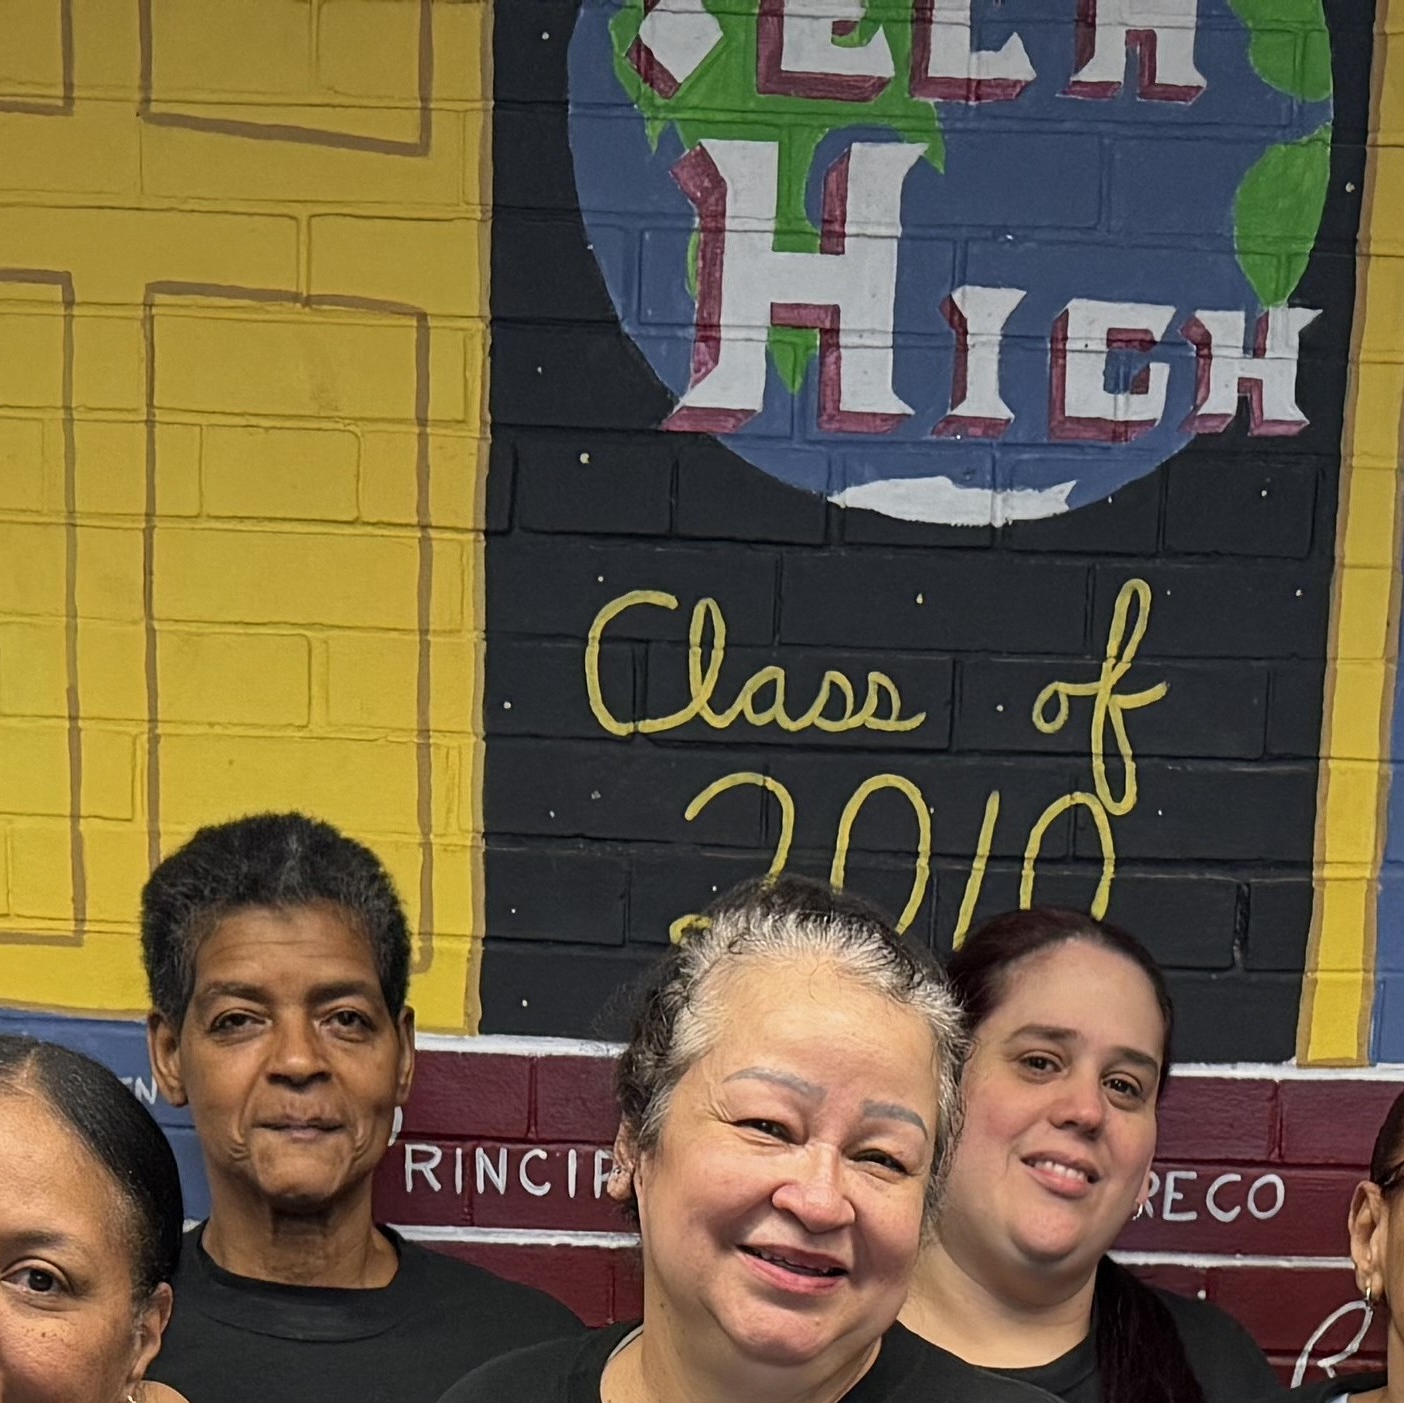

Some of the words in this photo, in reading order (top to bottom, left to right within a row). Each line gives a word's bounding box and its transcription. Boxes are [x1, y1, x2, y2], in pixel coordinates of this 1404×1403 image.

[661, 139, 1324, 442] HIGH
[586, 590, 927, 738] Class
[1032, 578, 1170, 815] of
